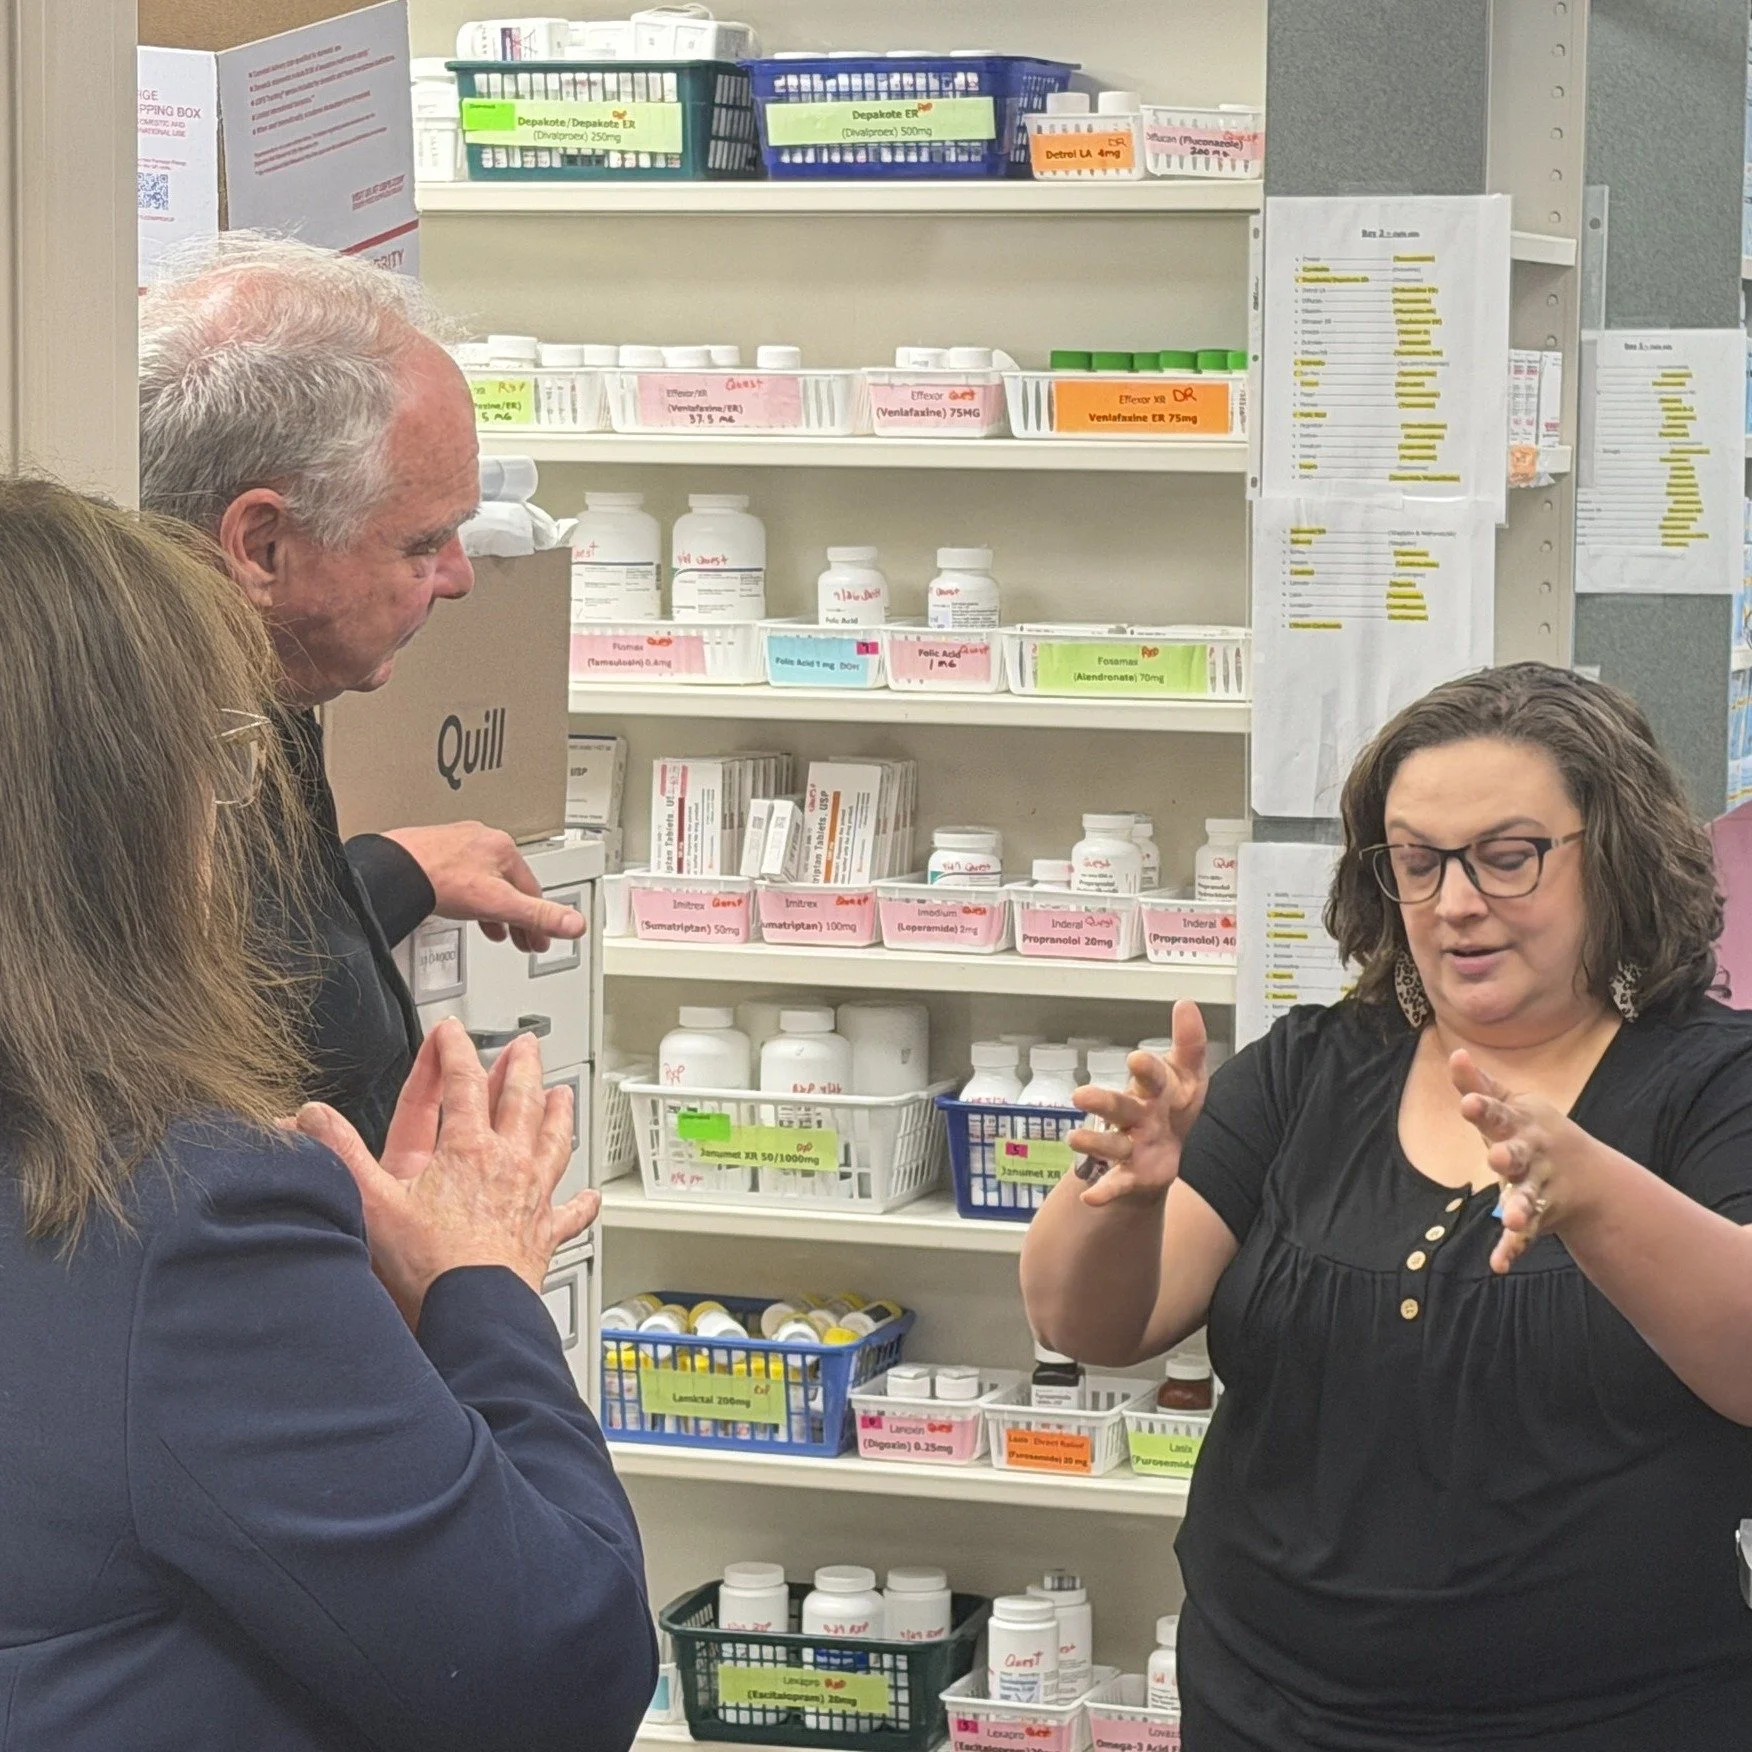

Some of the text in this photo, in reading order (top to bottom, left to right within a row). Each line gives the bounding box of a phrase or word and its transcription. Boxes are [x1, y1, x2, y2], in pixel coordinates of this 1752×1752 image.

[177, 107, 201, 119] BOX
[852, 109, 919, 121] Depakote ER
[517, 115, 636, 130] Depakote/Depakote ER
[533, 130, 622, 144] (Divalproex) 250mg
[842, 126, 932, 139] (Divalproex) 500mg
[1178, 135, 1244, 152] (Fluconazole)
[1045, 148, 1121, 160] Detrol LA 4mg
[724, 377, 763, 392] Quest
[910, 390, 944, 401] Effexor
[1118, 394, 1166, 405] Effexor XR
[1172, 386, 1198, 403] DR
[667, 404, 743, 415] (Venlafaxine/ER)
[876, 406, 981, 419] (Venlafaxine) 75MG
[1088, 412, 1198, 425] Venlafaxine ER 75mg
[918, 648, 961, 659] Folic Acid
[587, 657, 644, 669] (Tamsulosin)
[775, 657, 794, 667] Folic
[796, 658, 814, 668] Acid
[821, 661, 835, 672] mg
[1097, 656, 1139, 667] Fosamax
[1073, 672, 1165, 684] (Alendronate) 70mg
[437, 707, 506, 791] Quill
[672, 899, 705, 911] Imitrex
[784, 898, 818, 909] Imitrex
[917, 908, 958, 918] Imodium
[641, 919, 740, 937] (Sumatriptan) 50mg
[825, 921, 857, 934] 100mg
[897, 922, 979, 937] (Loperamide) 2mg
[1051, 919, 1084, 929] Inderal
[1182, 918, 1217, 929] Inderal
[1022, 935, 1114, 949] Propranolol 20mg
[1149, 933, 1220, 947] (Propranolol)
[700, 1148, 820, 1166] Janumet XR 50/1000mg
[1001, 1168, 1044, 1179] Janumet
[672, 1393, 714, 1404] Lamictal
[889, 1423, 925, 1435] Lanoxin
[863, 1438, 954, 1455] (Digoxin) 0.25mg
[1169, 1442, 1193, 1453] Lasix
[1008, 1451, 1062, 1464] (Furosemide)
[1004, 1650, 1044, 1668] Quest
[782, 1676, 821, 1688] Lexapro
[747, 1689, 825, 1704] (Escitalopram)
[986, 1728, 1025, 1740] Lexapro
[1095, 1739, 1144, 1751] Omega-3
